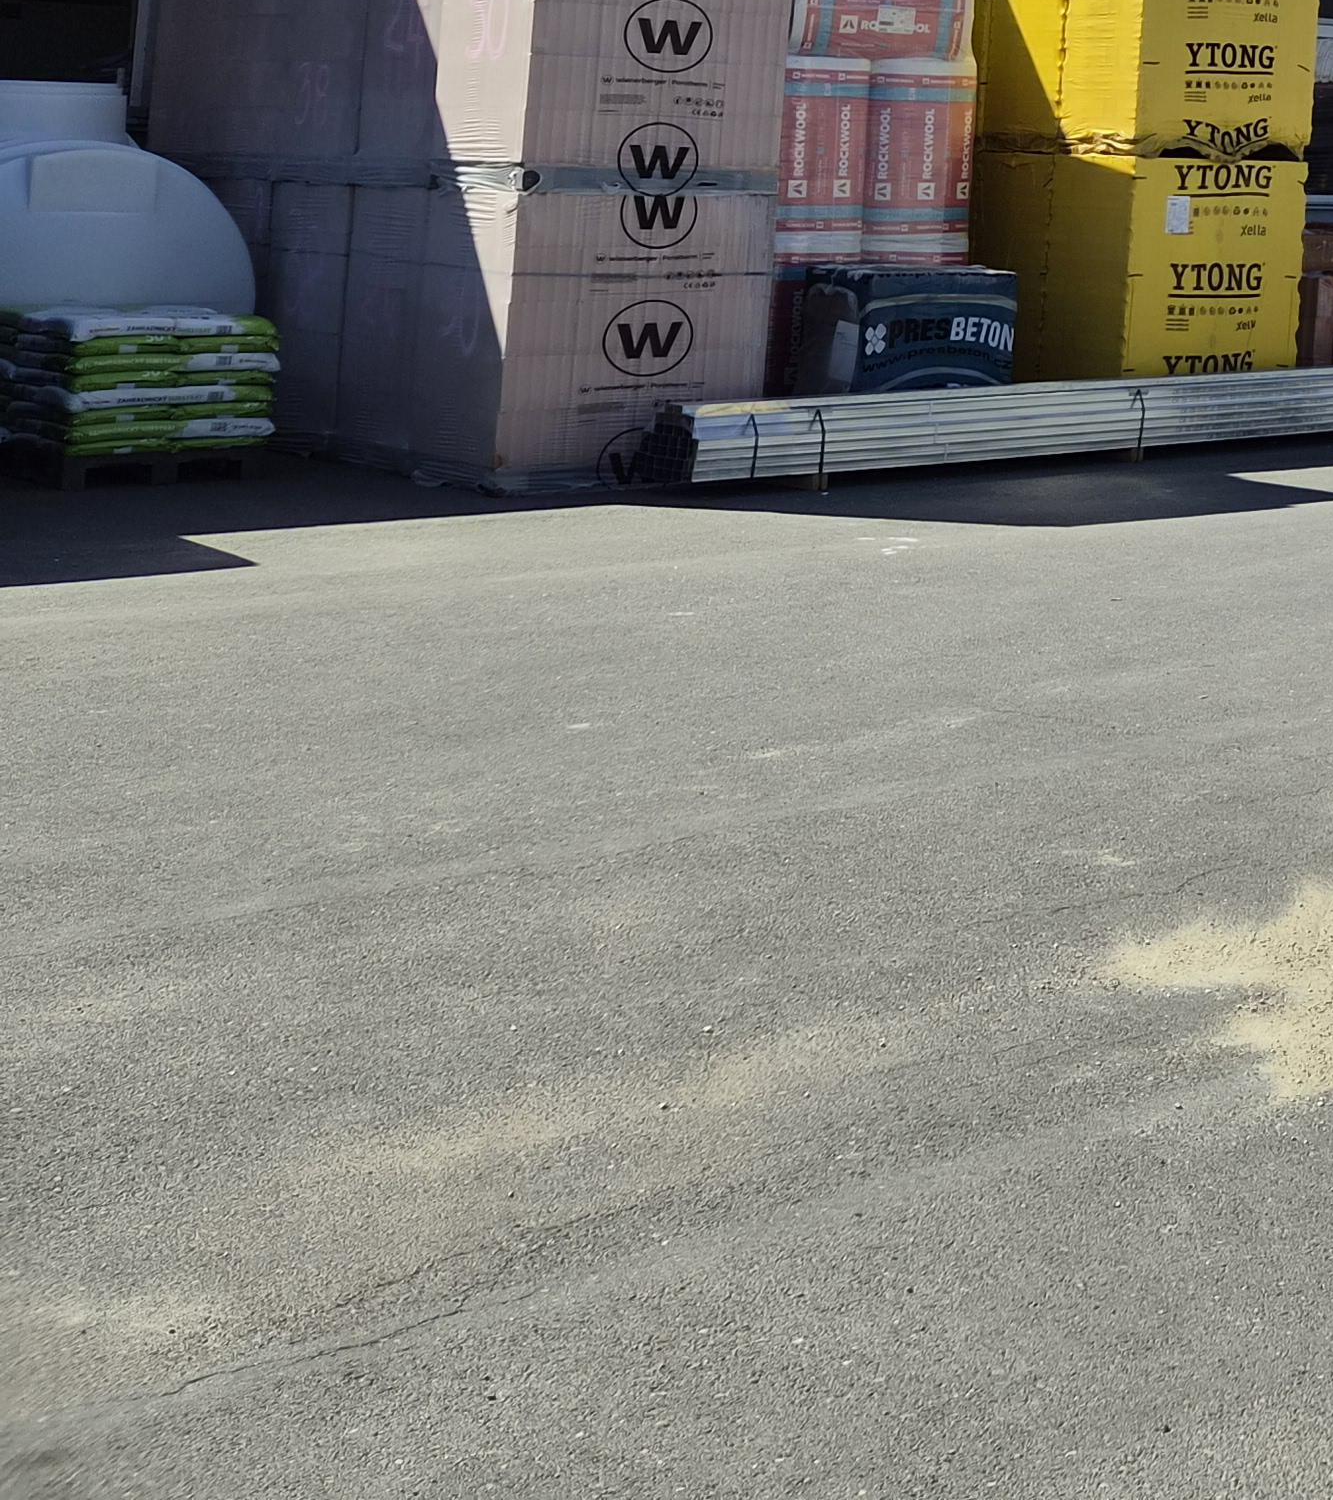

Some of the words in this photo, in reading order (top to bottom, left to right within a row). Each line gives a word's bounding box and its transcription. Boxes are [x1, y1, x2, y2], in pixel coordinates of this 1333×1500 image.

[637, 18, 703, 56] W
[1185, 42, 1275, 69] YTONG
[793, 102, 807, 177] ROCKWOOL
[838, 103, 851, 177] ROCKWOOL
[877, 107, 891, 180] ROCKWOOL
[922, 108, 936, 180] ROCKWOOL
[961, 109, 973, 180] ROCKWOOL
[1183, 117, 1269, 156] YTONG
[629, 144, 691, 180] W
[1174, 163, 1273, 191] YTONG
[634, 195, 685, 231] W
[1170, 262, 1263, 291] YTONG
[617, 320, 684, 360] W
[888, 316, 1015, 352] PRESBETON
